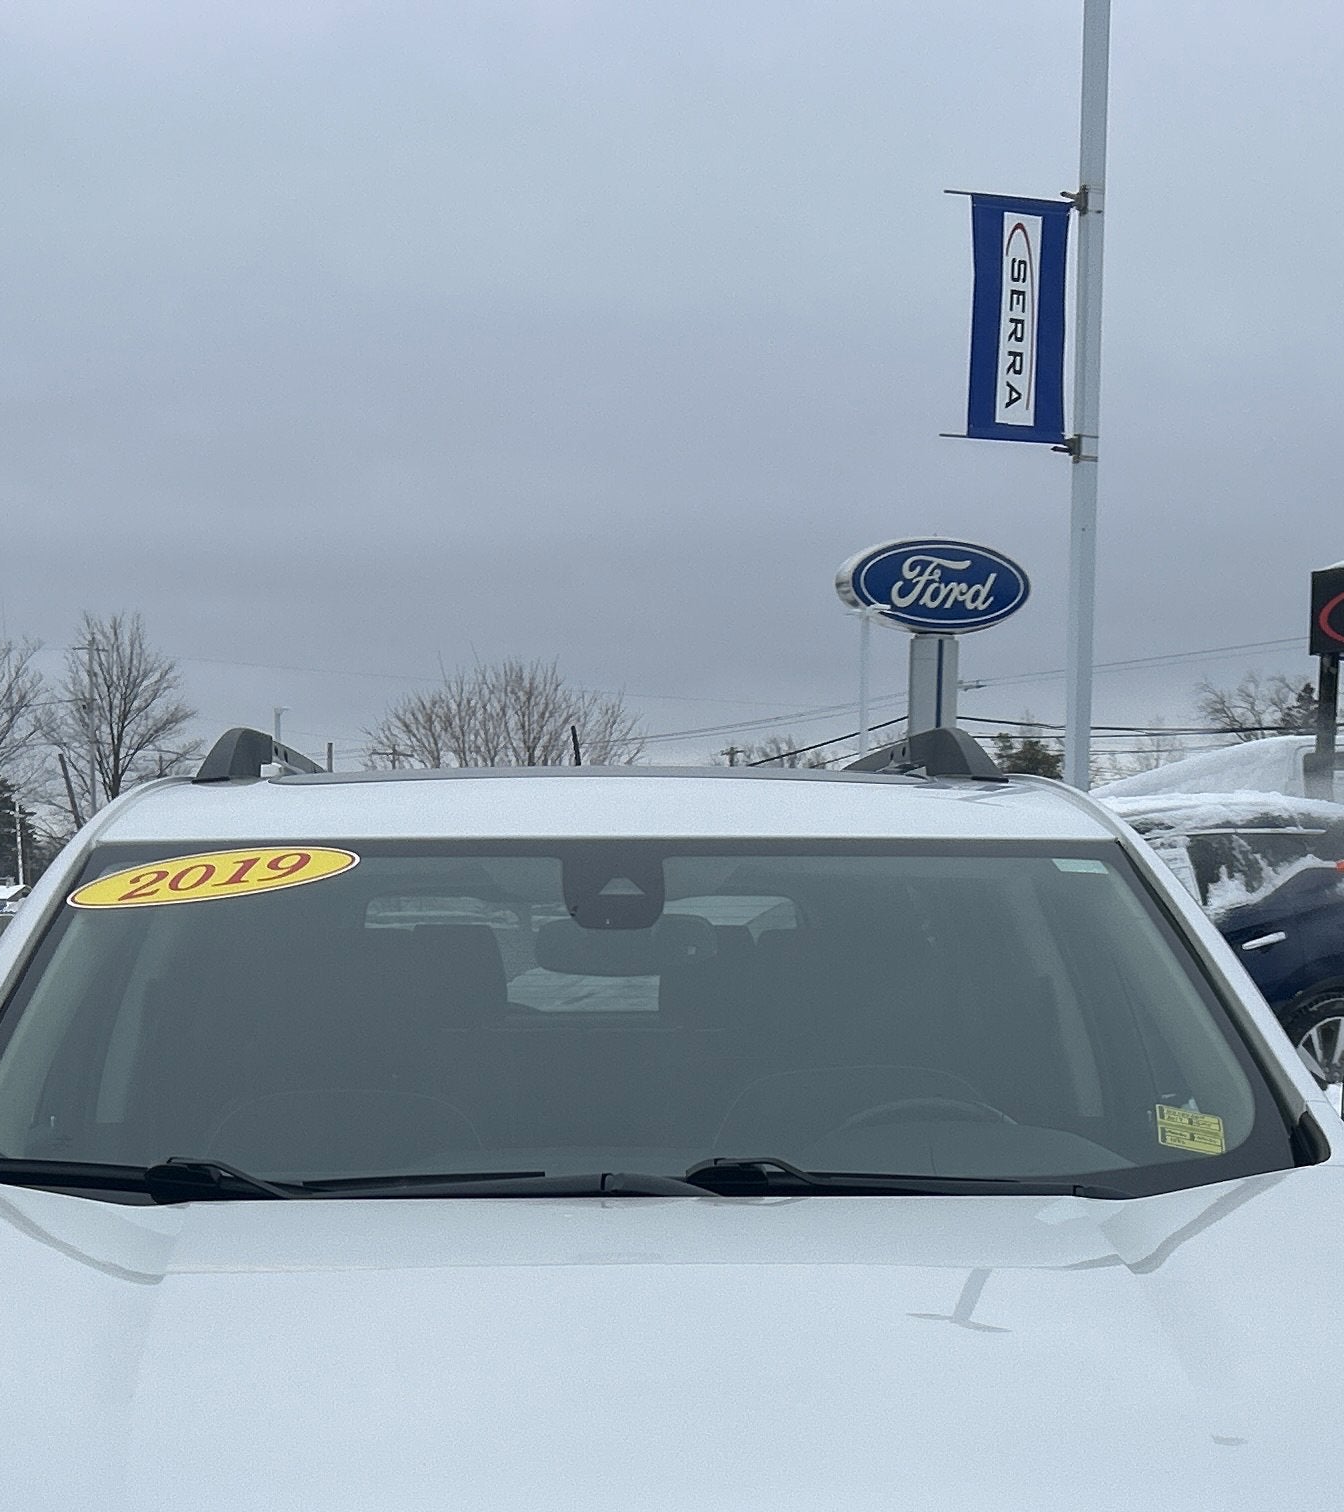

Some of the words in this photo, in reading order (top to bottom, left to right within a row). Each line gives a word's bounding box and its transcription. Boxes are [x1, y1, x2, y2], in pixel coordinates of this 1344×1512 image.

[1004, 257, 1028, 409] SERRA
[890, 554, 998, 611] Ford
[117, 852, 312, 902] 2019
